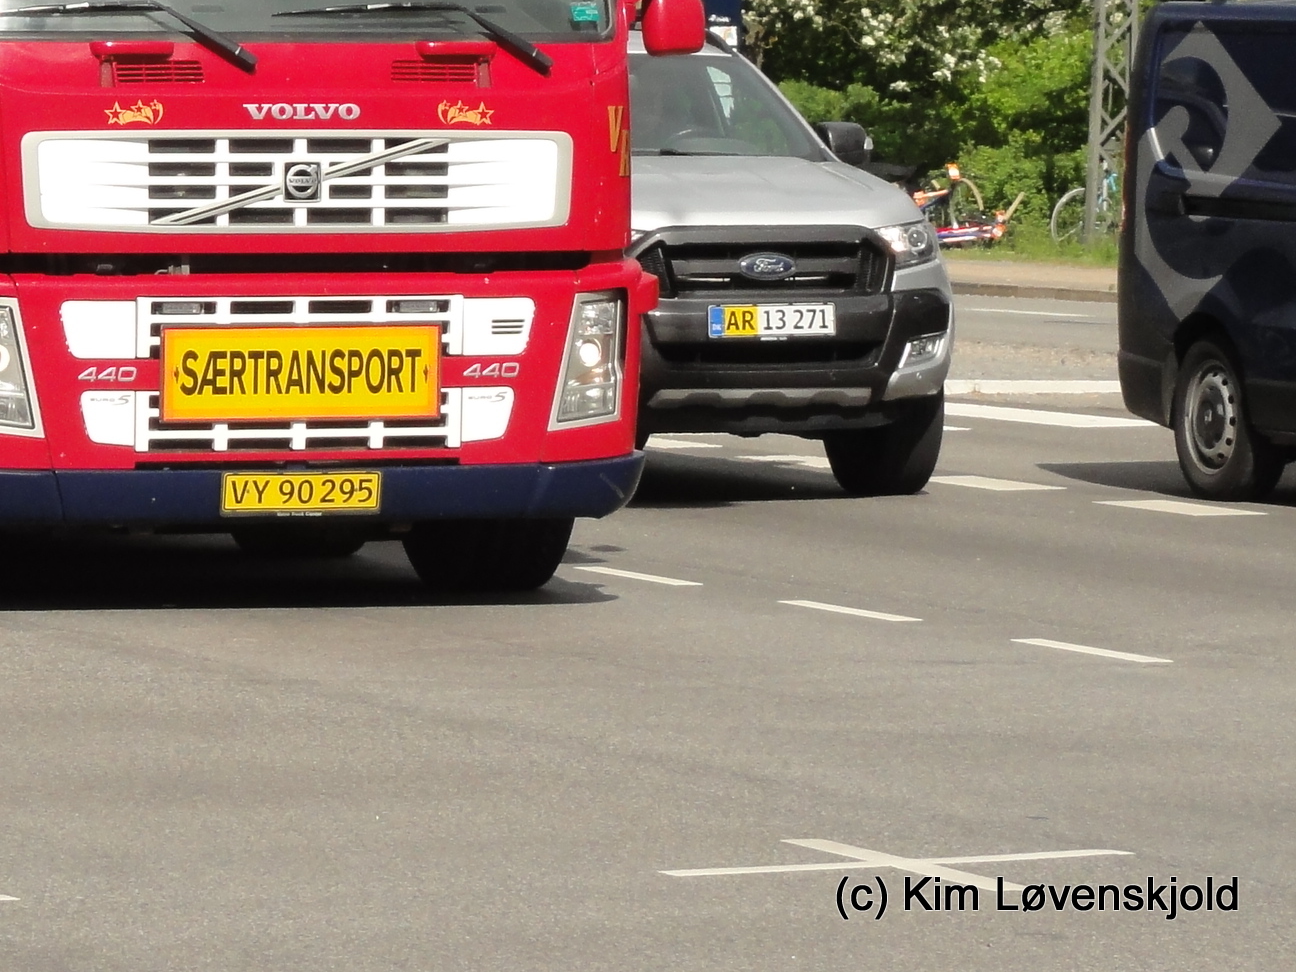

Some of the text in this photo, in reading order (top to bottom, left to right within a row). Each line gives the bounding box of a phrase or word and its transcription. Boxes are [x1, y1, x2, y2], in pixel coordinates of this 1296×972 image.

[243, 103, 361, 120] VOLVO
[288, 176, 317, 184] VOLVO
[727, 309, 829, 330] AR 13 271
[78, 366, 137, 382] 440
[179, 348, 422, 396] SÆRTRANSPORT
[463, 362, 520, 378] 440
[231, 478, 373, 505] VY 90 295
